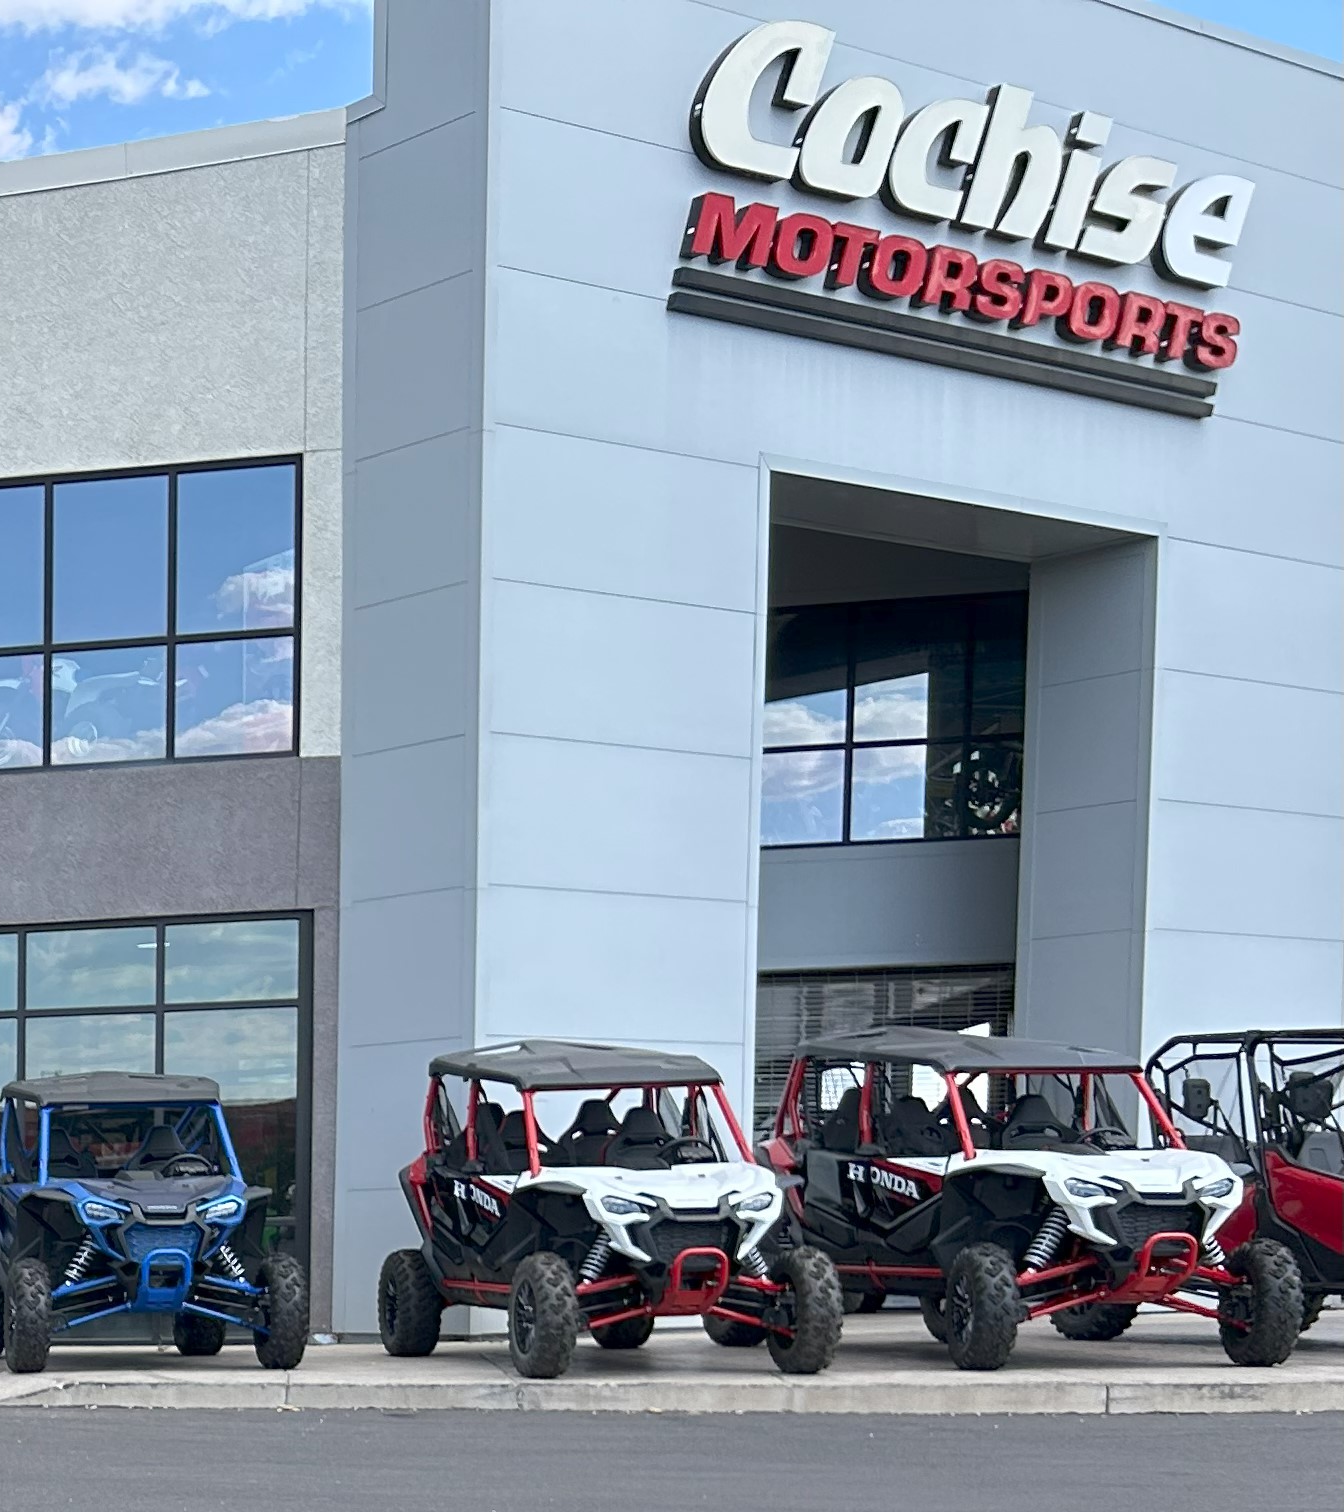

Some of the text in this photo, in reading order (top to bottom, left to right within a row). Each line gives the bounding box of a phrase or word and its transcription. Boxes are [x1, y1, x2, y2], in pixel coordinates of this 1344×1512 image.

[690, 19, 1256, 288] Cochise
[682, 191, 1241, 371] MOTORSPORTS
[453, 1180, 501, 1218] HONDA
[847, 1162, 920, 1200] HONDA
